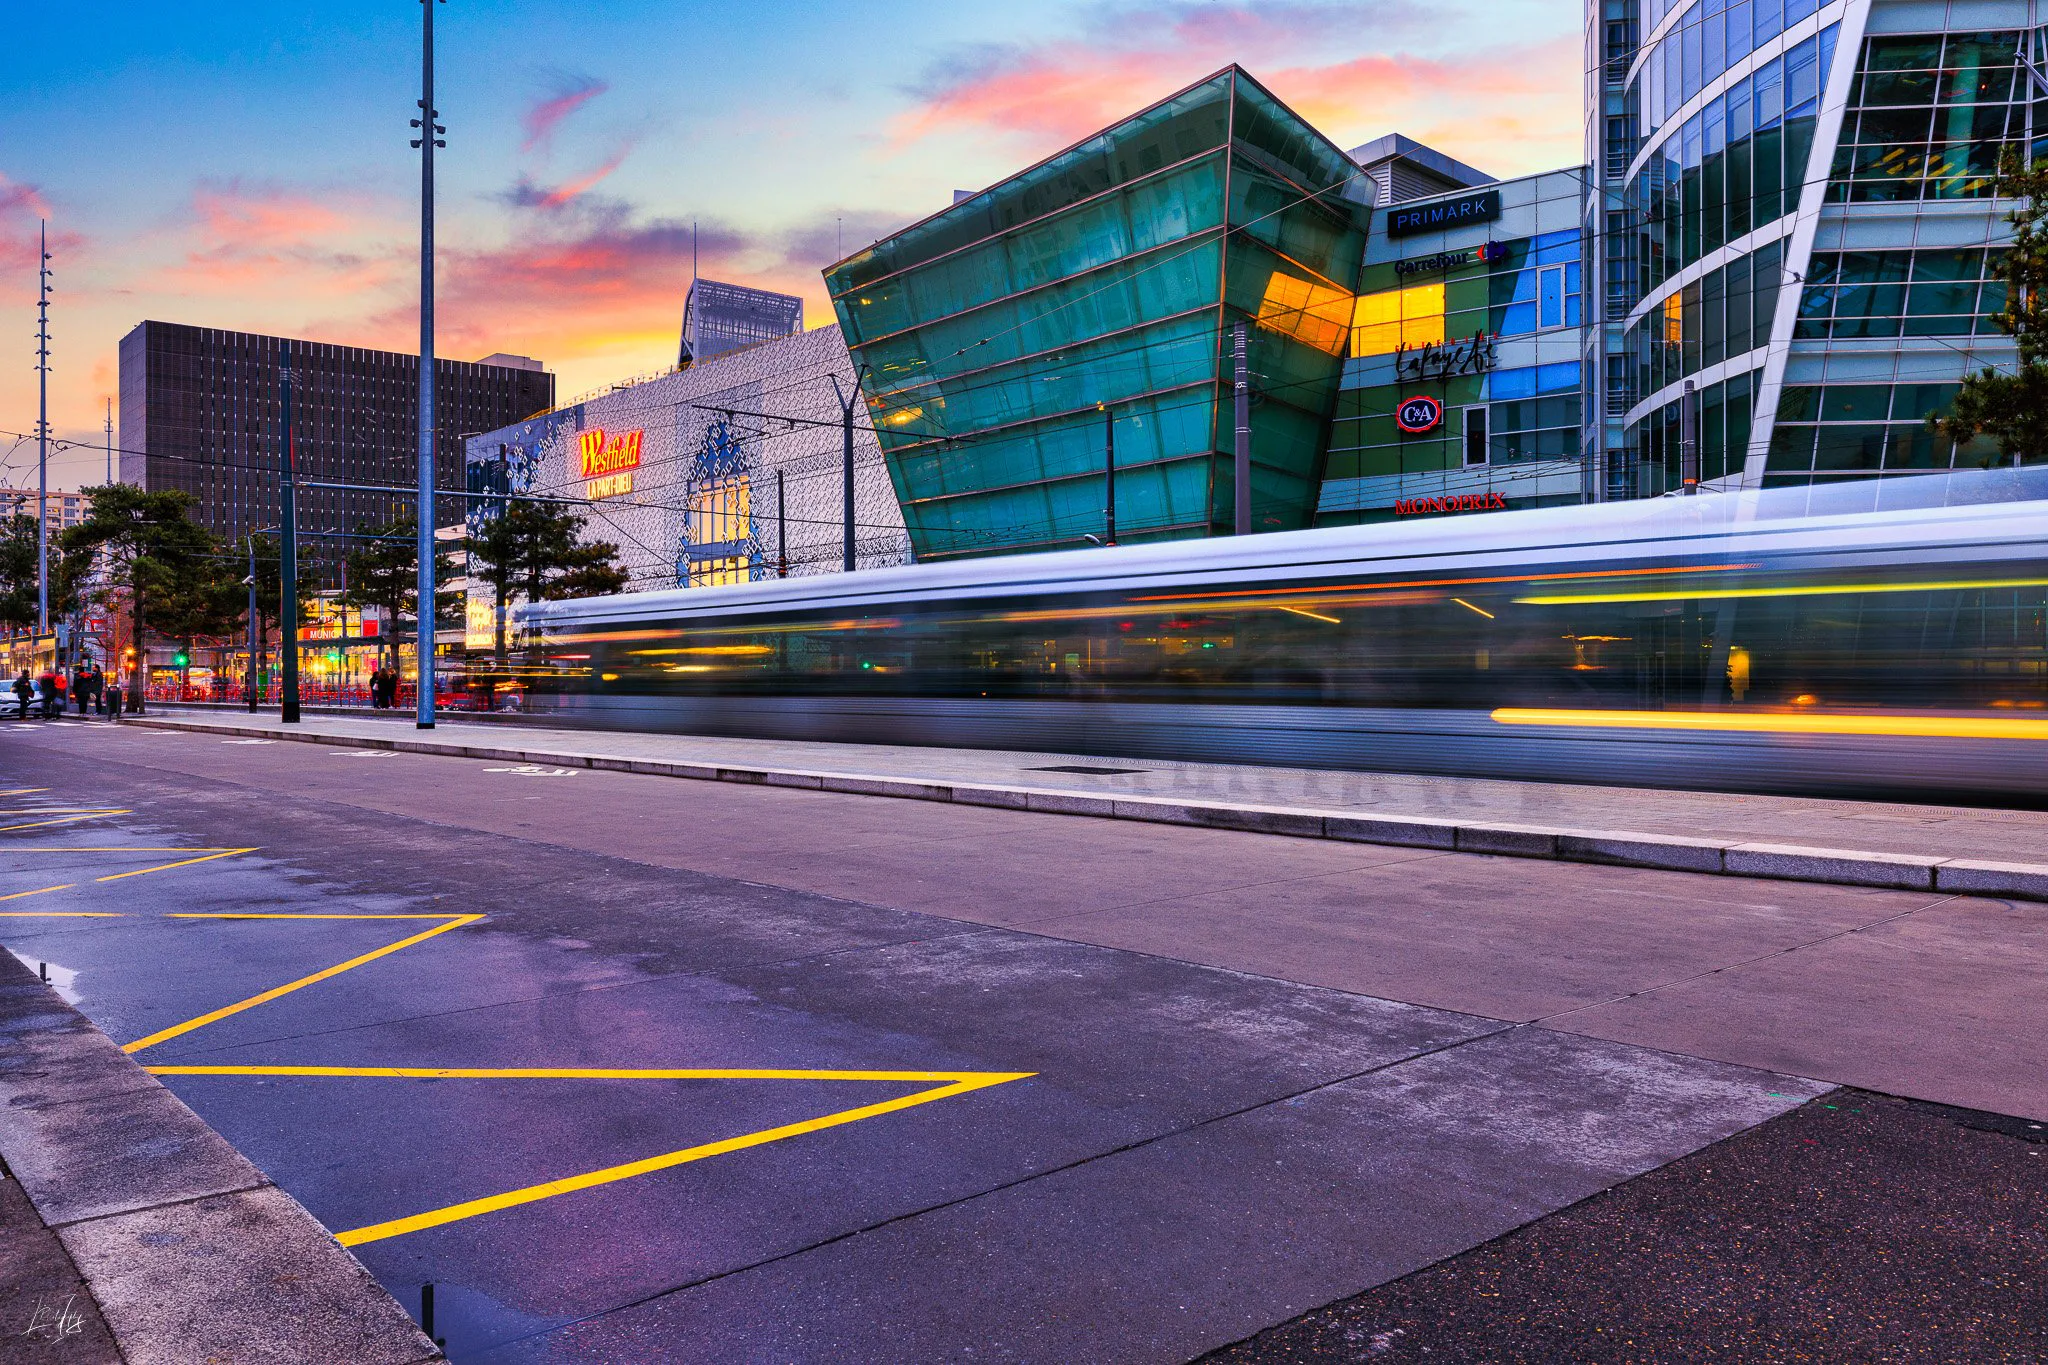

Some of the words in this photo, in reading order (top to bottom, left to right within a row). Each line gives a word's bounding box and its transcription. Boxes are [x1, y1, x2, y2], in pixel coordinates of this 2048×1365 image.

[1397, 199, 1486, 229] PRIMARK
[1394, 251, 1469, 275] Carrefour
[1404, 405, 1432, 422] C&A
[580, 429, 640, 477] Westfield
[587, 480, 597, 499] LA
[597, 473, 632, 497] PART-DIEU
[1395, 492, 1506, 515] MONOPRIX
